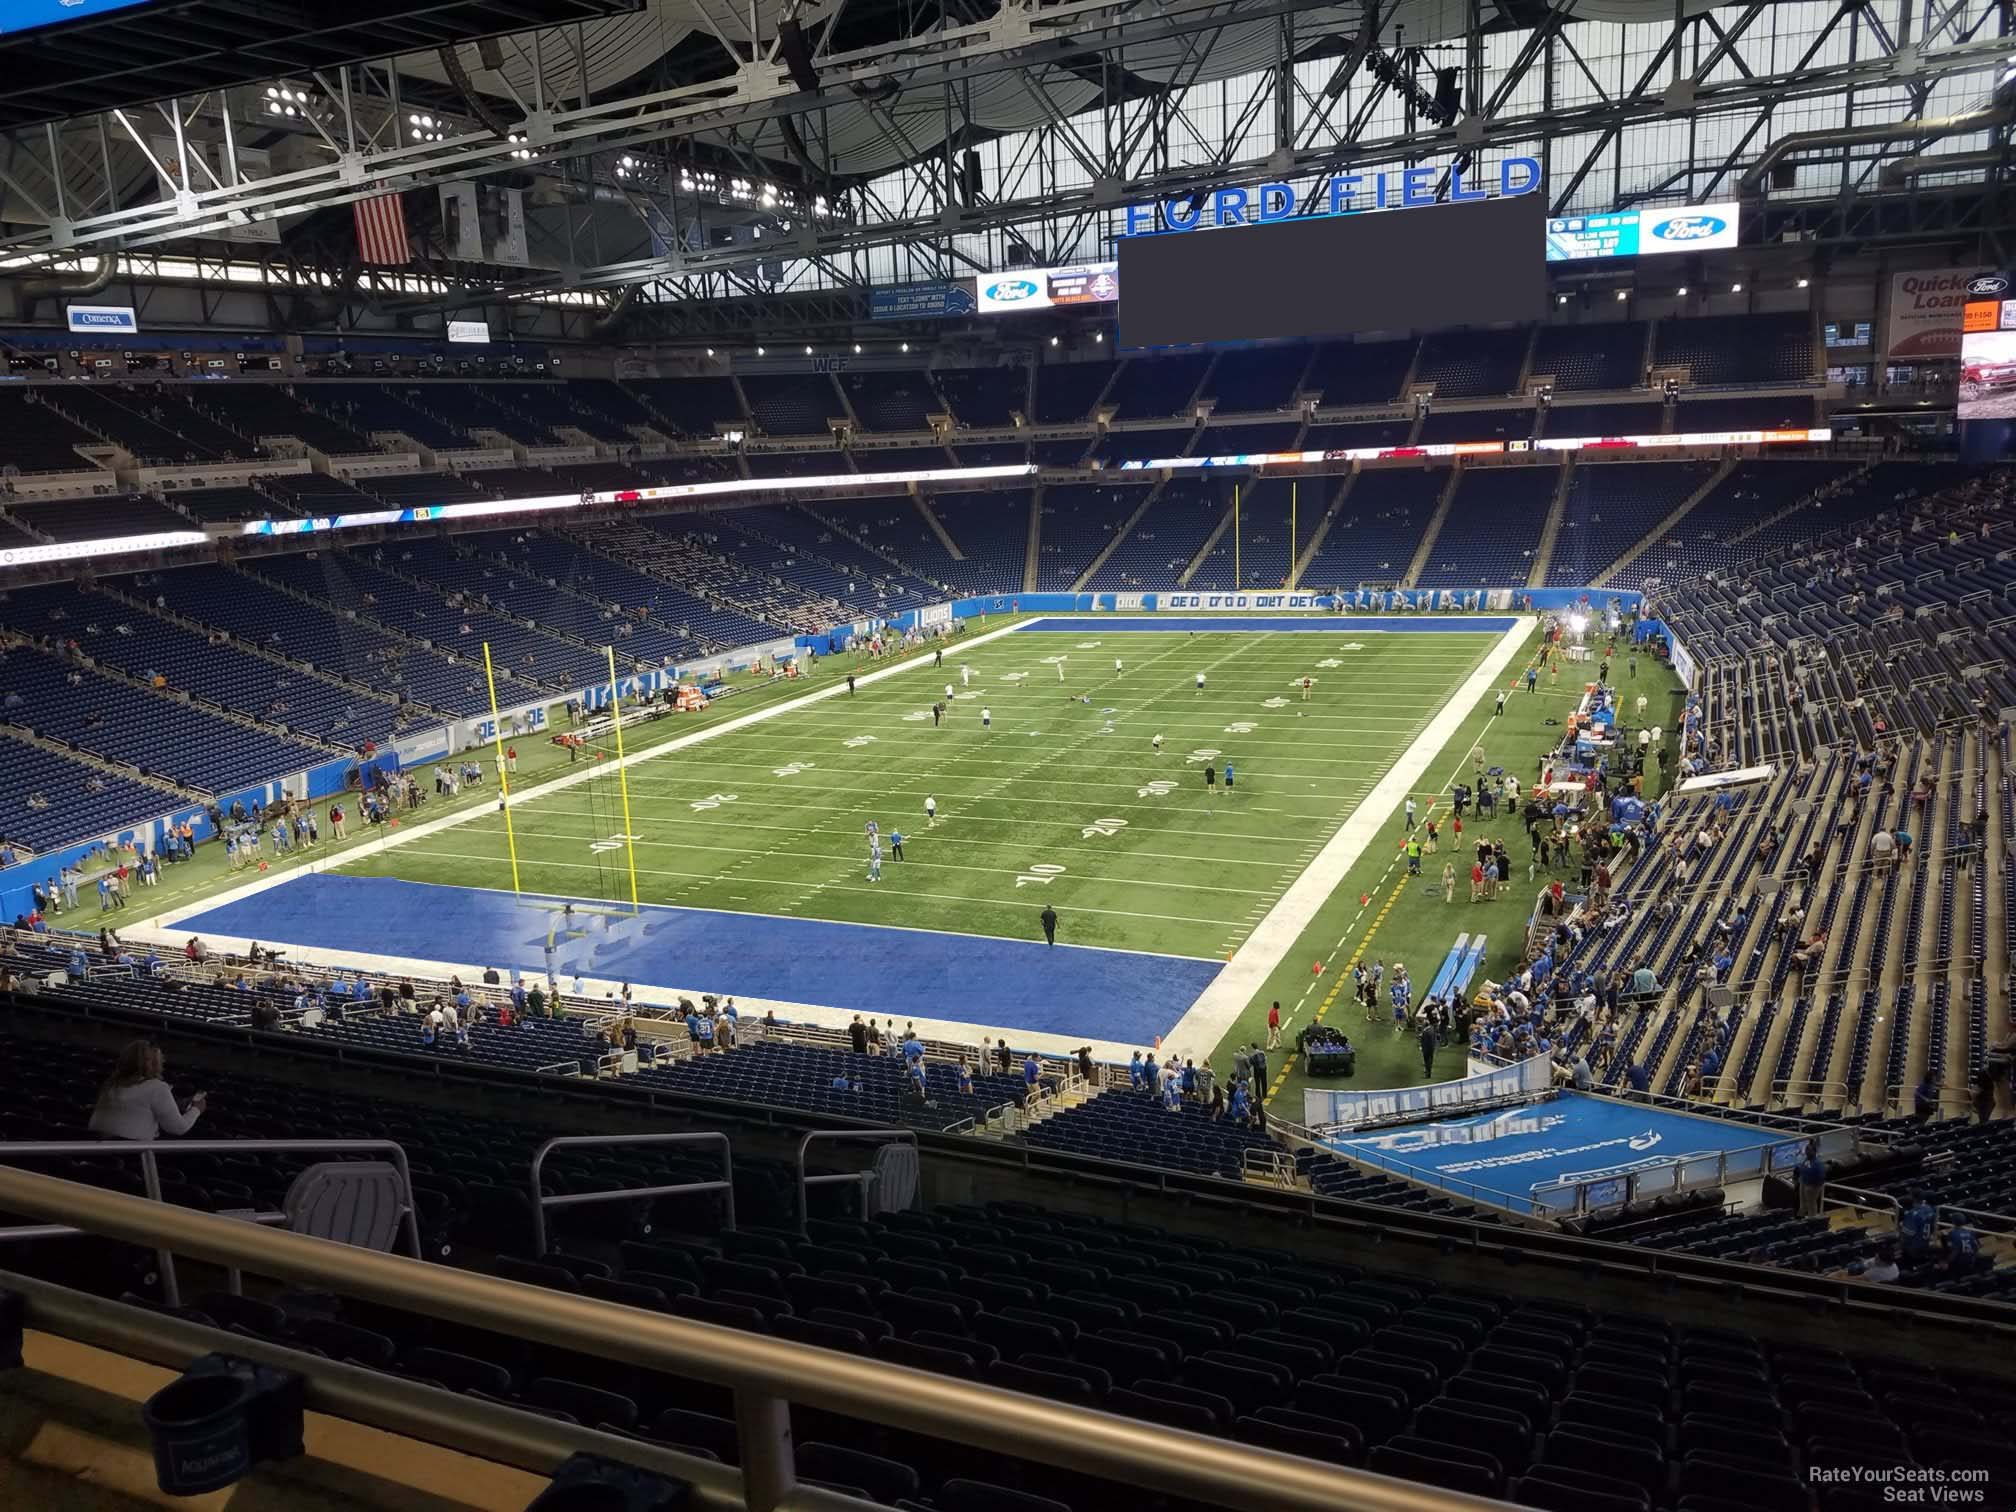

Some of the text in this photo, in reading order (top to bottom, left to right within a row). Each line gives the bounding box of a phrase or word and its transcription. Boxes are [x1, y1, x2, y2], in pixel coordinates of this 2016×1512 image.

[1126, 157, 1541, 236] FORD FIELD
[1661, 217, 1714, 239] Ford
[991, 280, 1031, 299] Ford
[925, 606, 950, 623] LIONS
[1137, 780, 1179, 796] 30
[1082, 818, 1128, 836] 20
[1016, 864, 1066, 884] 10
